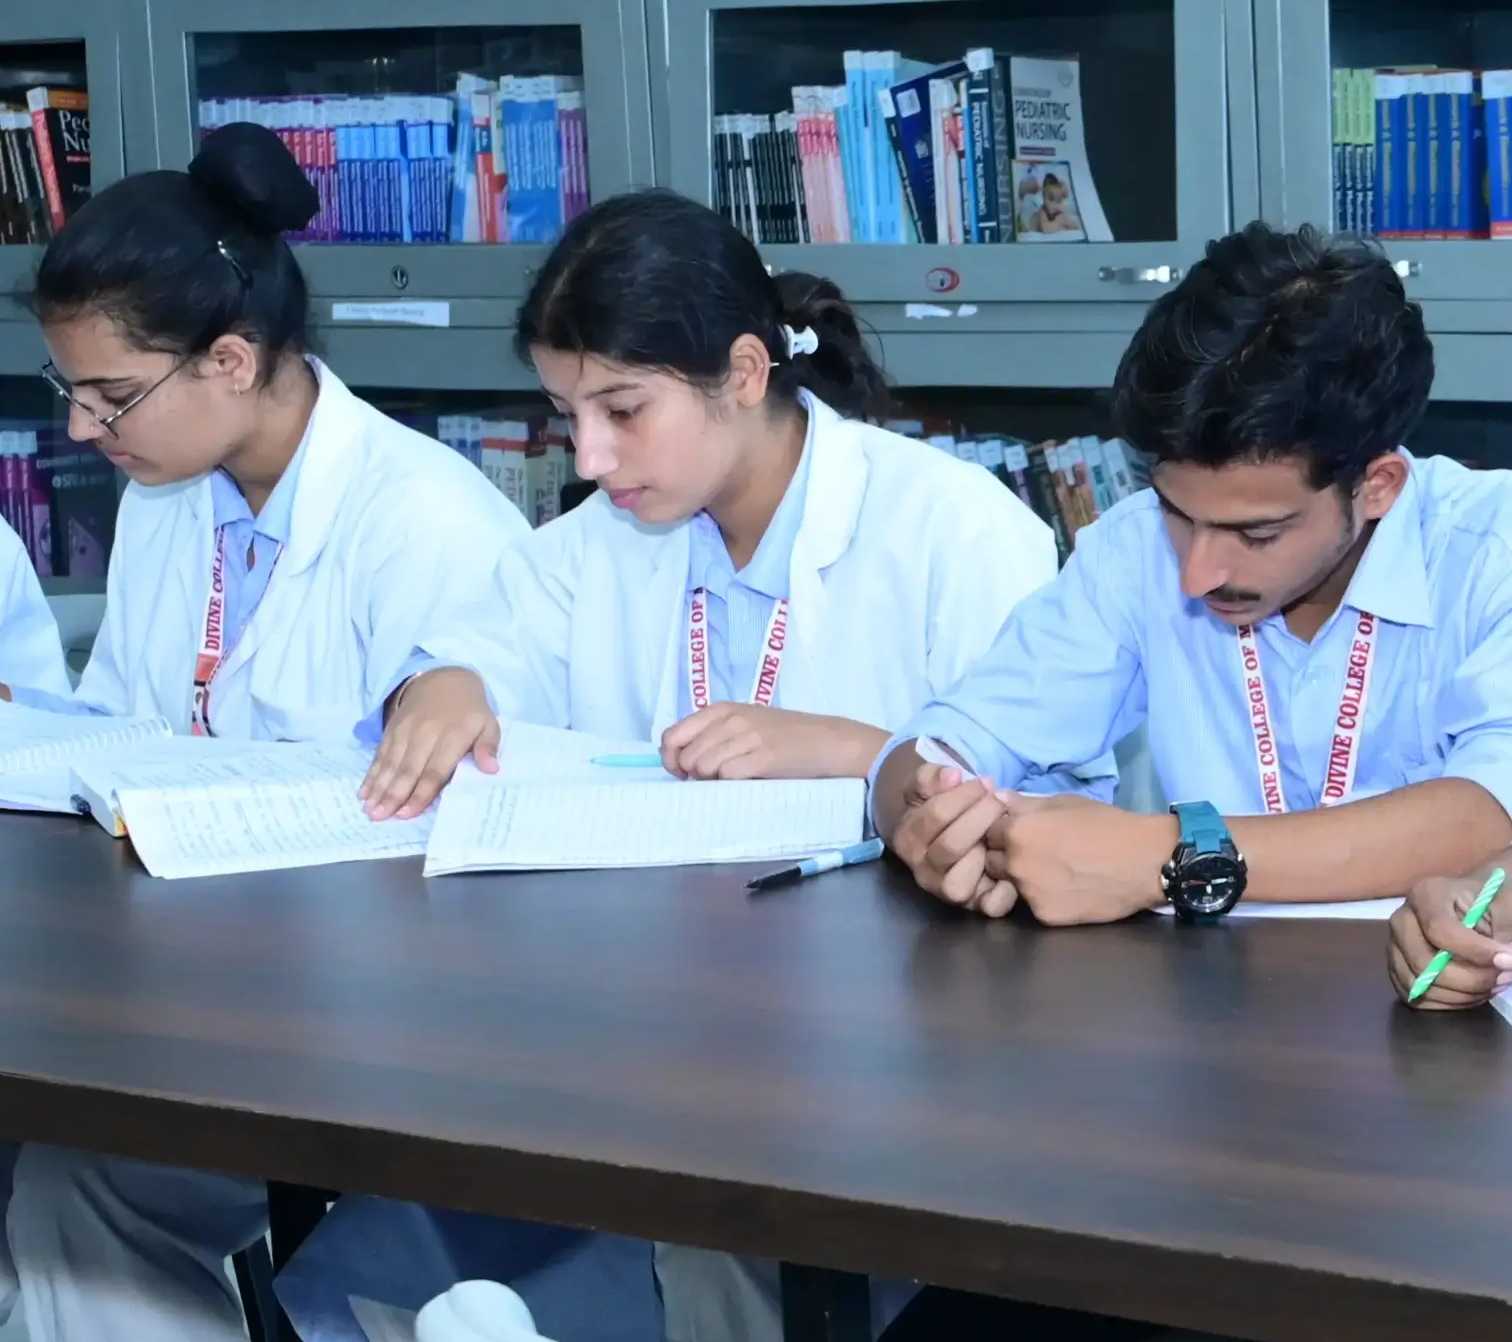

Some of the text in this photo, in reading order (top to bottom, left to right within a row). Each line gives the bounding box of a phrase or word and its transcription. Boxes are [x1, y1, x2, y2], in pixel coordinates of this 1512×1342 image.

[1015, 100, 1071, 121] PEDIATRIC
[1016, 123, 1067, 141] NURSING
[972, 101, 987, 215] PEDIATRIC NURSING
[205, 596, 222, 651] DIVINE
[691, 600, 708, 709] COLLEGE OF
[1242, 645, 1258, 671] OF
[1337, 640, 1370, 730] COLLEGE
[1248, 676, 1275, 766] COLLEGE
[1324, 734, 1352, 799] DIVINE
